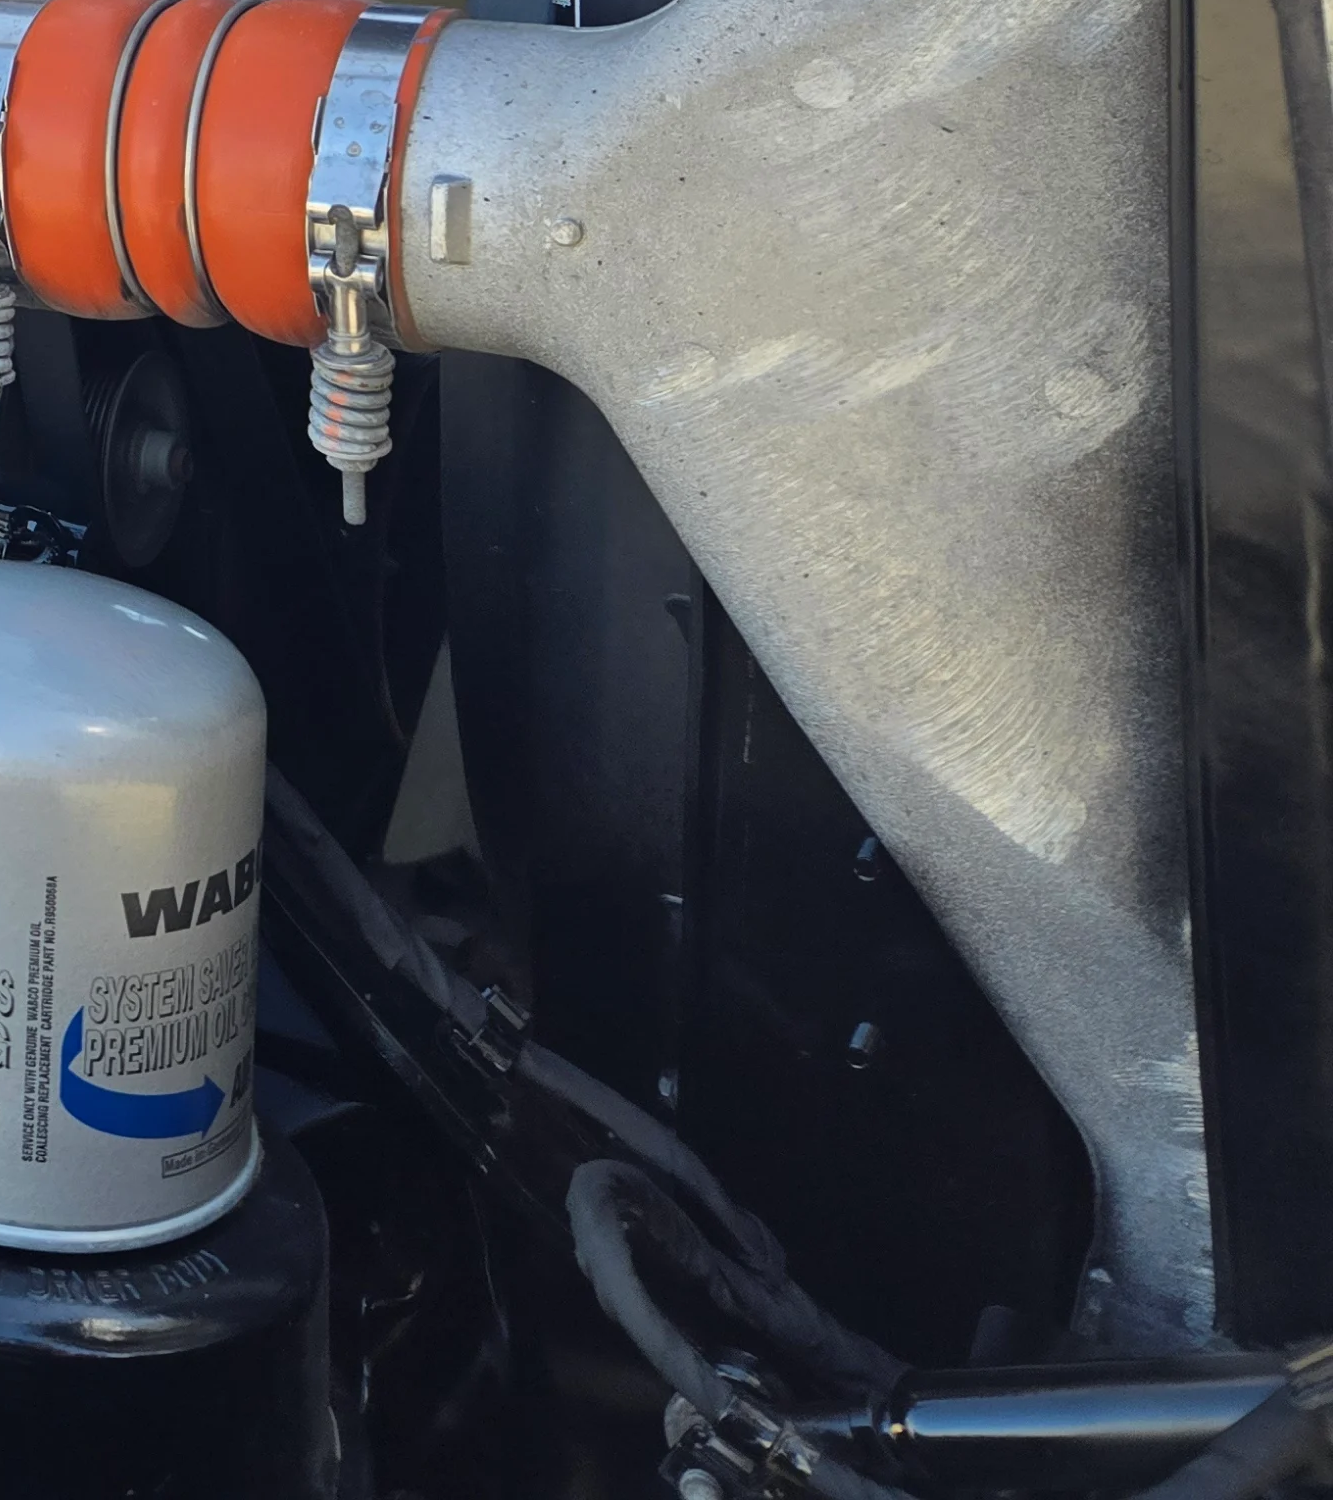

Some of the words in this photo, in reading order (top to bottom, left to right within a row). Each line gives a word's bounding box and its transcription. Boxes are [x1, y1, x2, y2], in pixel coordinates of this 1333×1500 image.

[30, 921, 42, 937] OIL
[28, 938, 41, 985] PREMIUM
[42, 946, 55, 972] PART
[27, 987, 39, 1021] WABCO
[40, 974, 54, 1030] CARTRIDGE
[88, 964, 195, 1025] SYSTEM
[25, 1026, 38, 1067] GENUINE
[84, 1010, 208, 1077] PREMIUM
[212, 995, 239, 1049] OIL
[24, 1069, 37, 1094] WITH
[37, 1035, 52, 1103] REPLACEMENT
[23, 1096, 35, 1121] ONLY
[21, 1122, 34, 1162] SERVICE
[35, 1105, 49, 1163] COALESCING
[164, 1154, 193, 1172] Made
